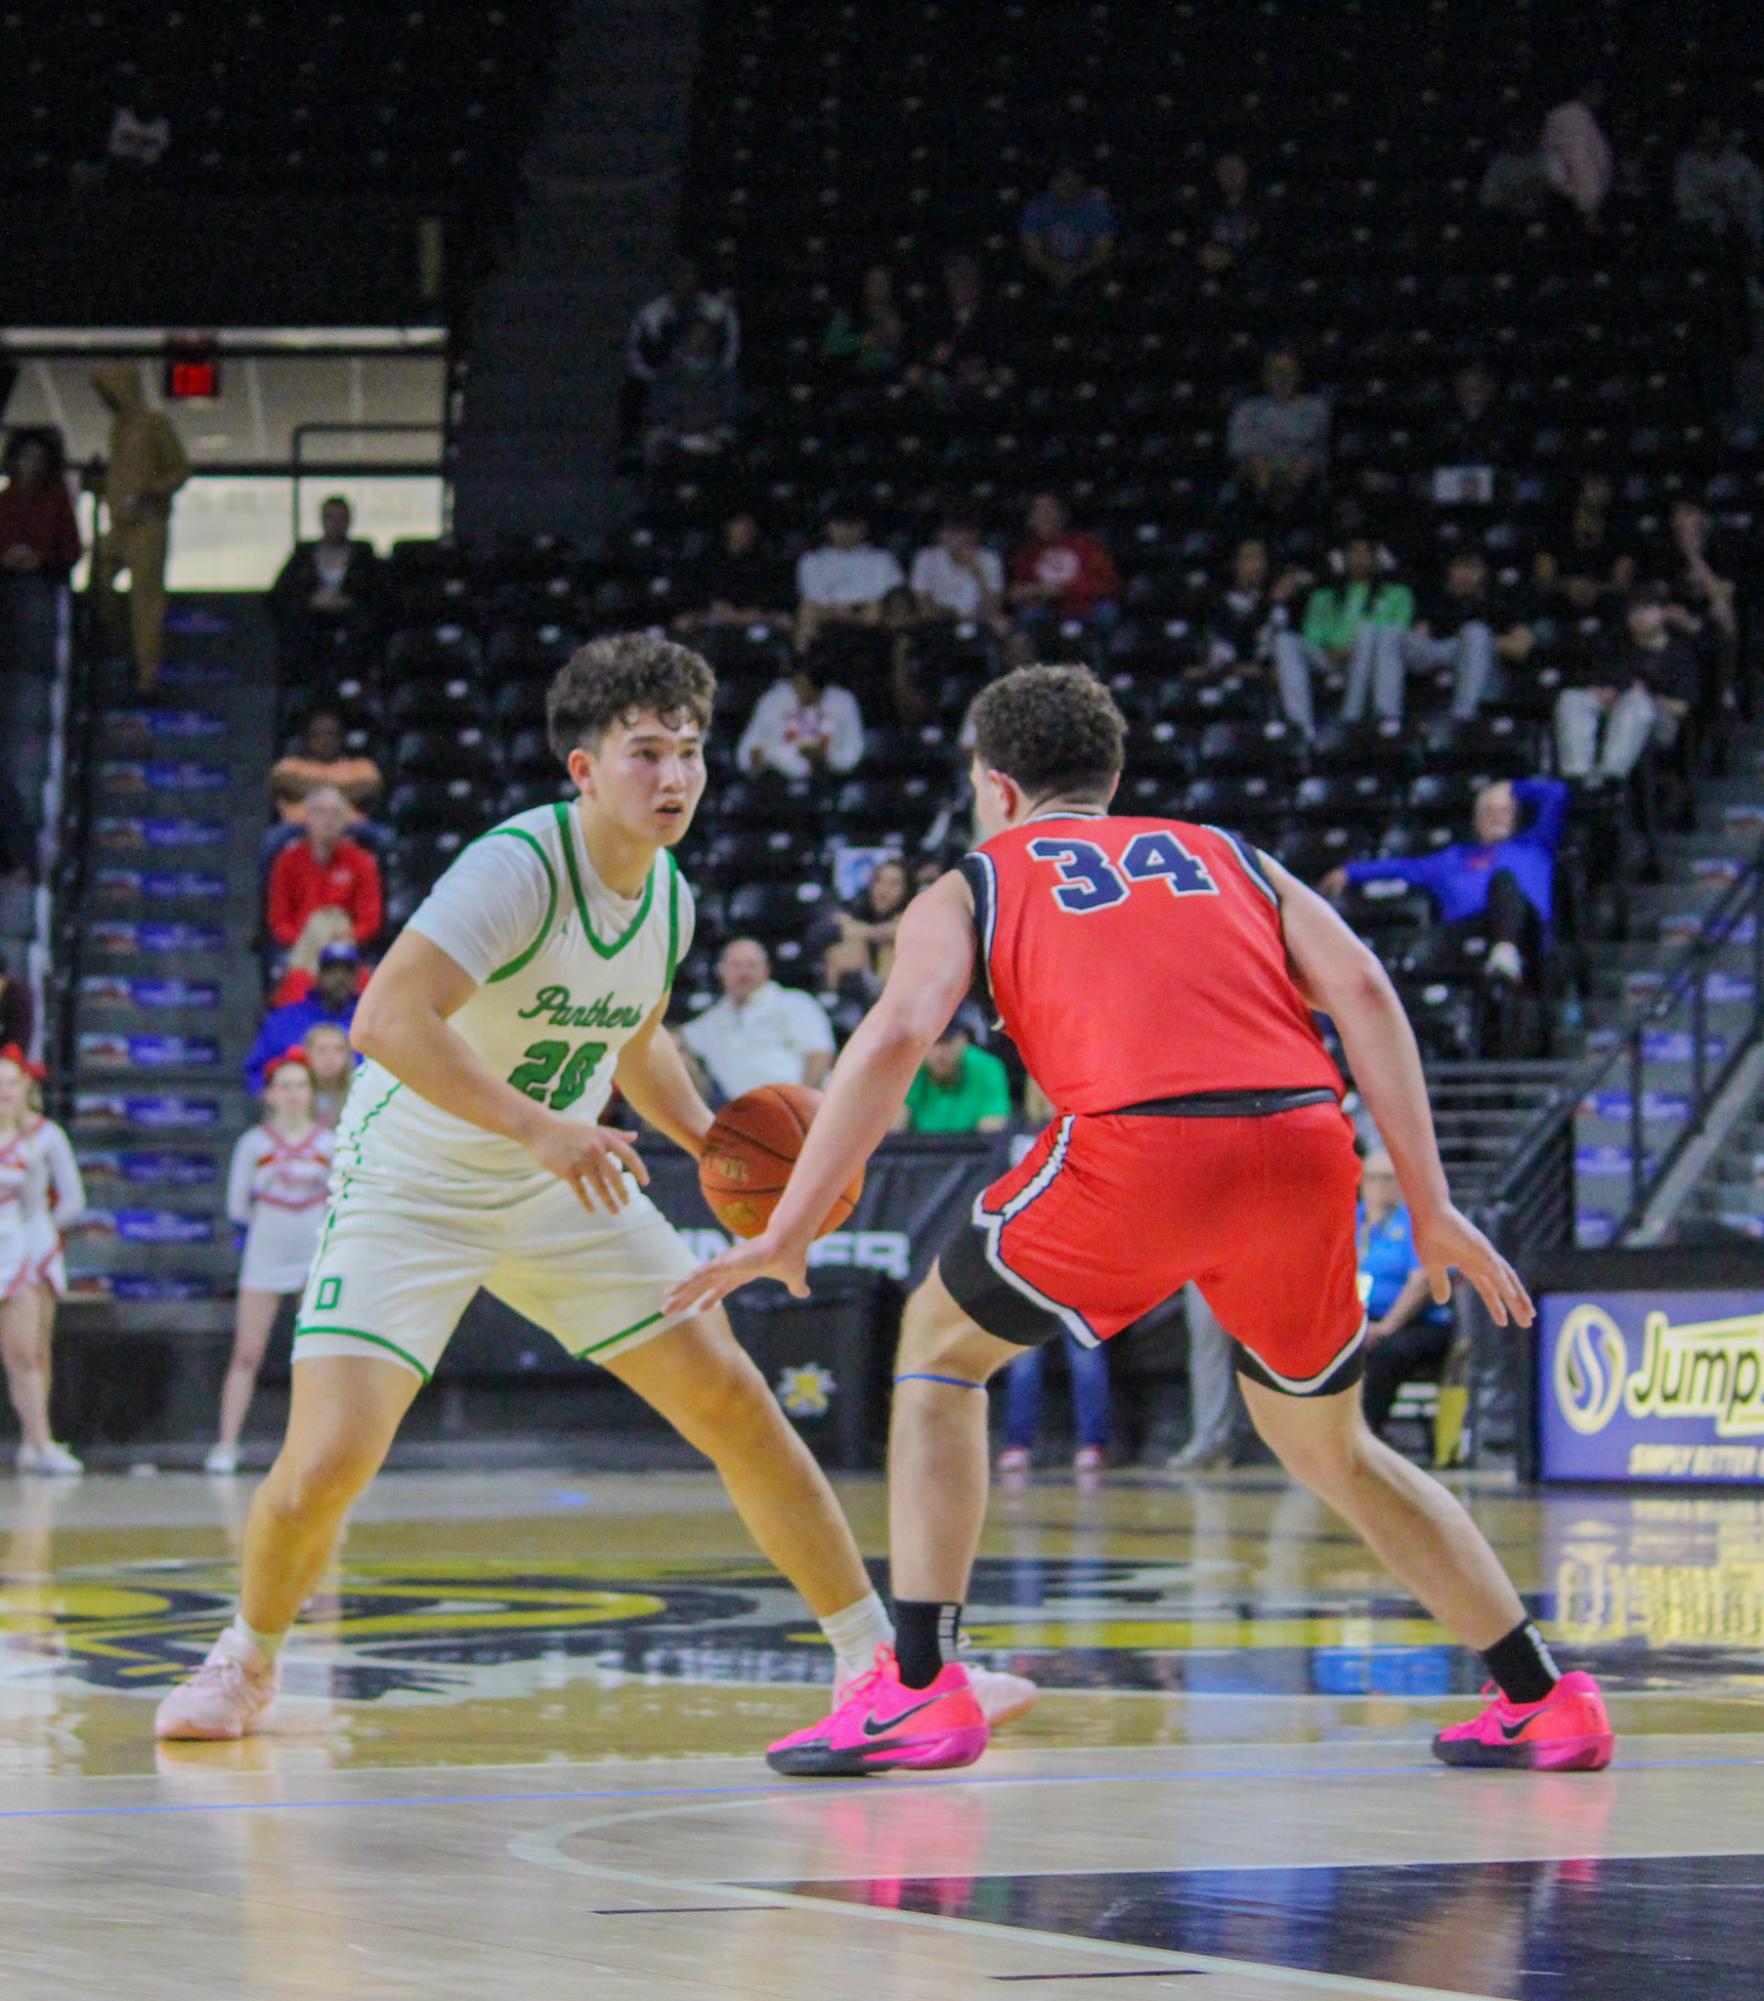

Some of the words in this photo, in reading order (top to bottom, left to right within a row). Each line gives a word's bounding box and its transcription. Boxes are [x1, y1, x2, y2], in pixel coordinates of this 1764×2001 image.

[1027, 829, 1220, 914] 34
[518, 985, 642, 1028] Panthers
[315, 1276, 343, 1310] D
[1627, 1315, 1764, 1430] Jump
